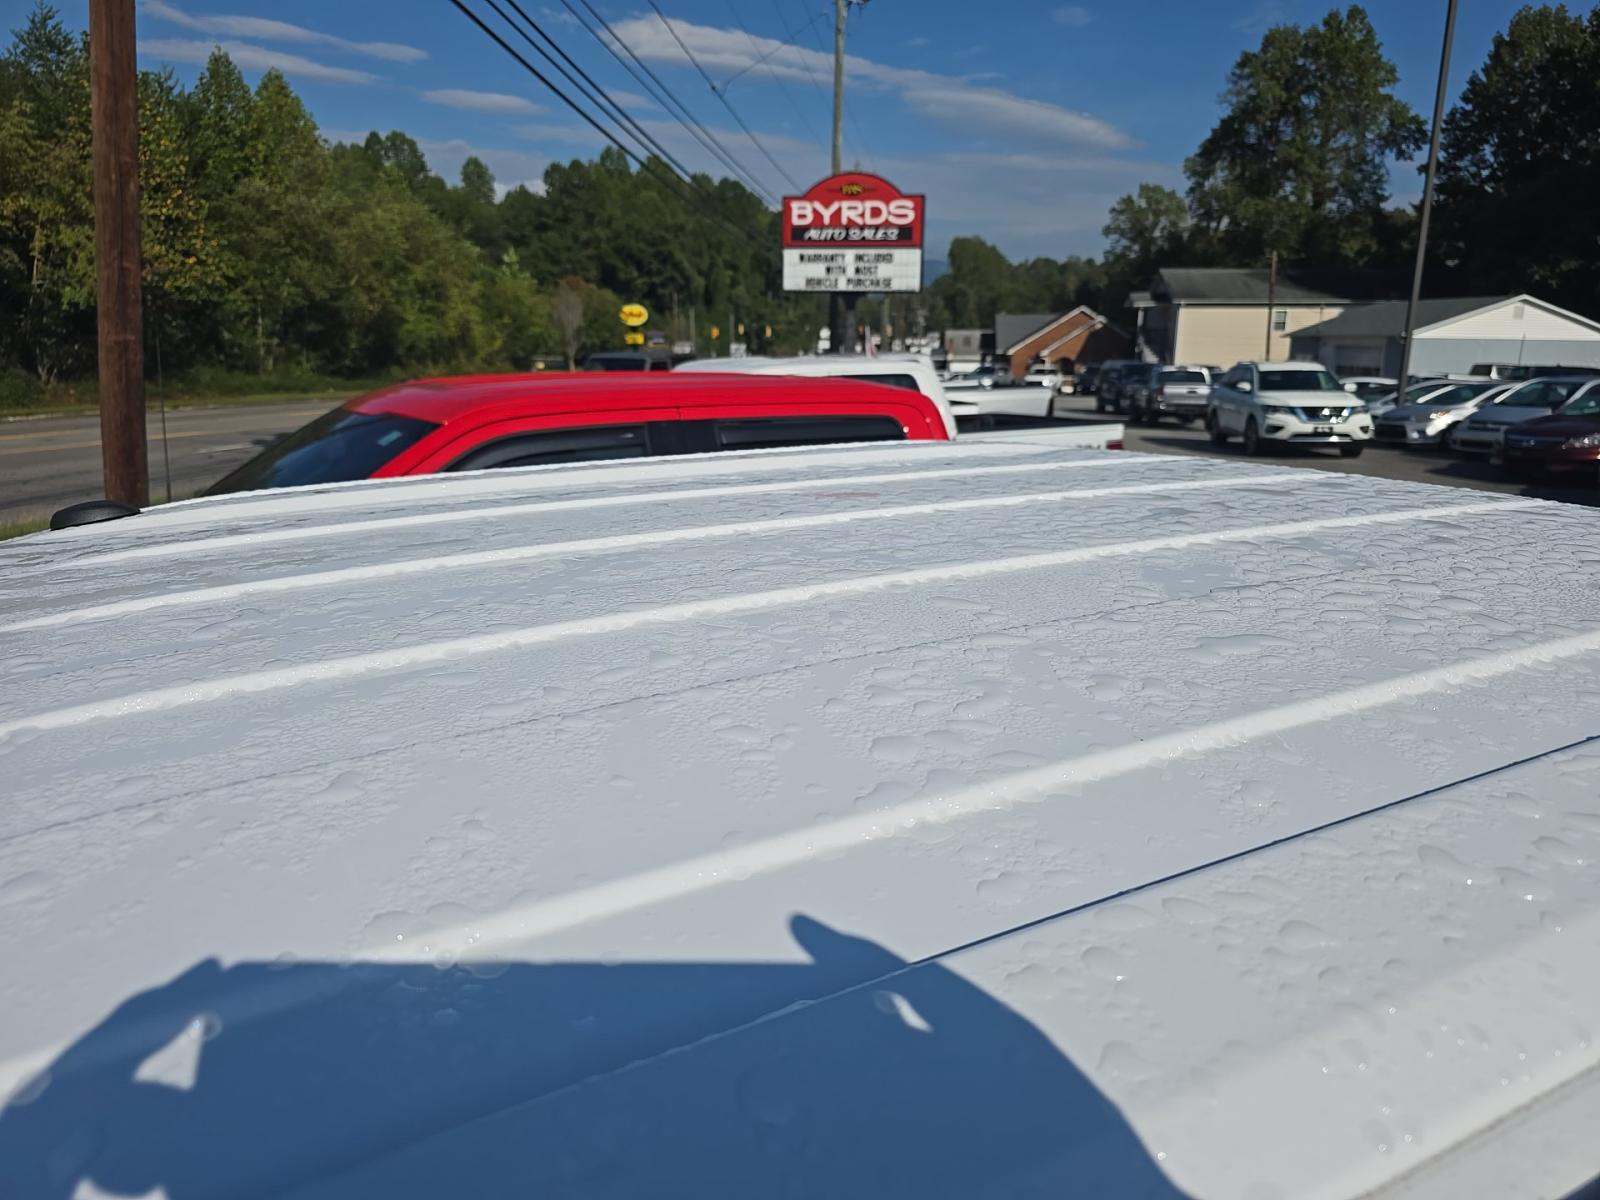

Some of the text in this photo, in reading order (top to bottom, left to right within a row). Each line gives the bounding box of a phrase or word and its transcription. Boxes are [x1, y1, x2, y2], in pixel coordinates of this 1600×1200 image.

[790, 199, 916, 226] BYRDS
[803, 226, 900, 241] AUTO SALES
